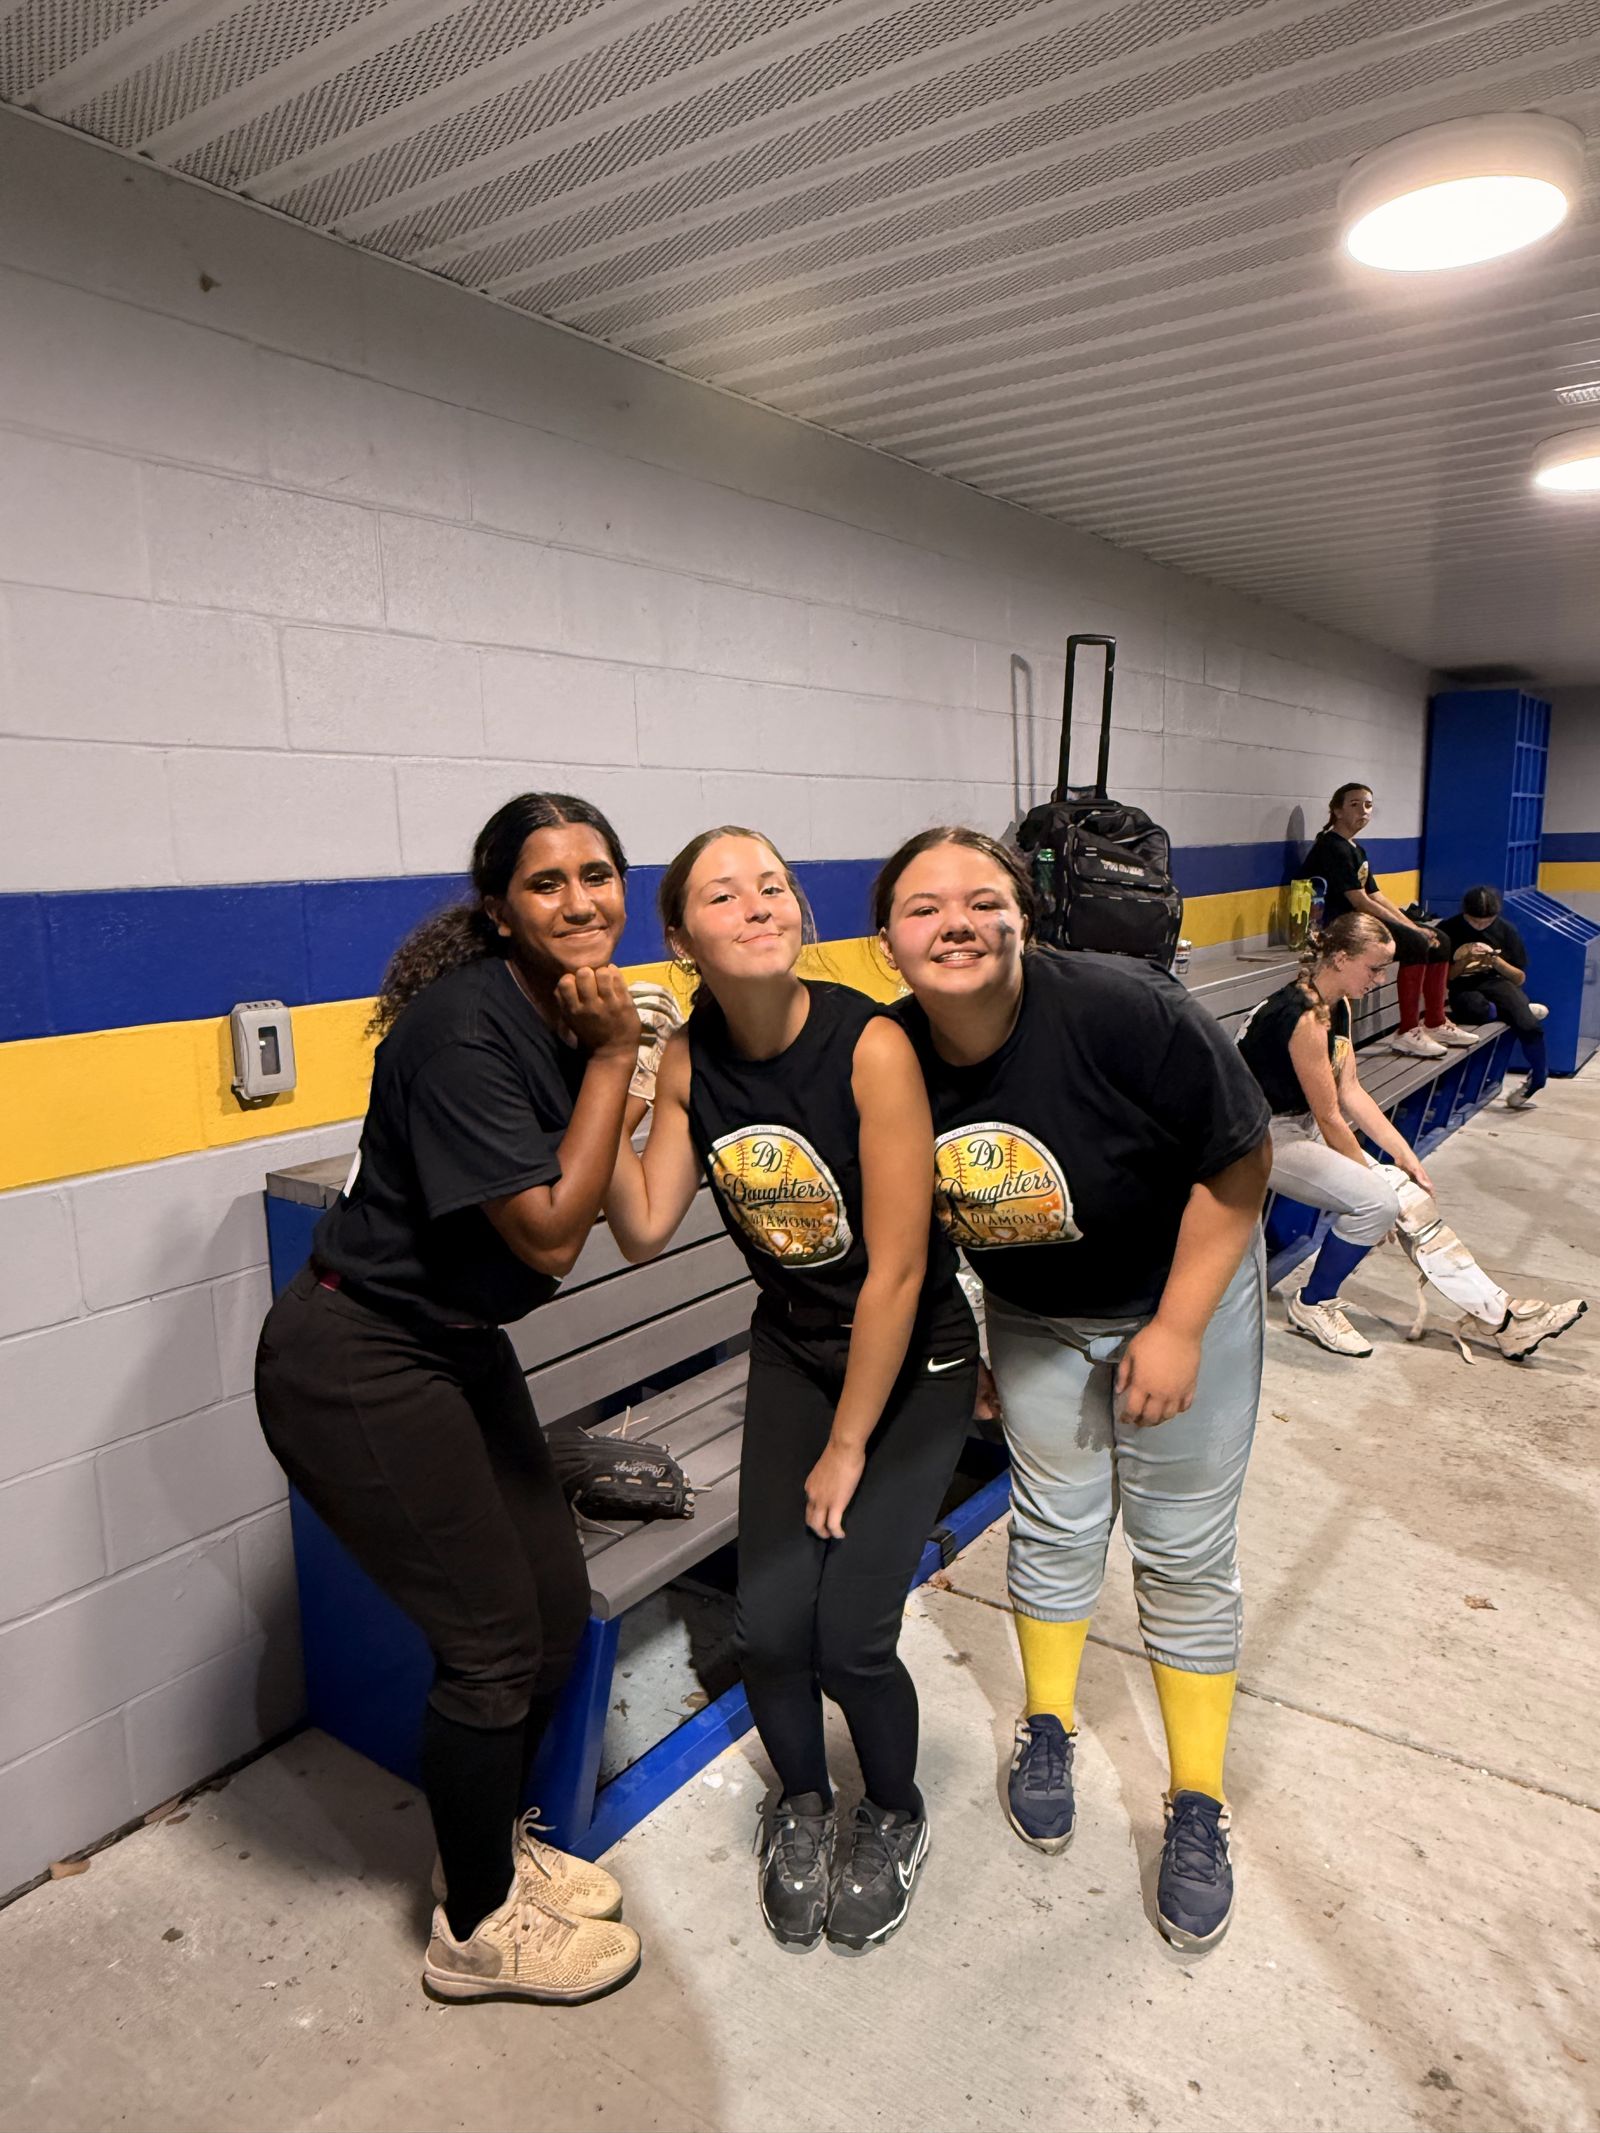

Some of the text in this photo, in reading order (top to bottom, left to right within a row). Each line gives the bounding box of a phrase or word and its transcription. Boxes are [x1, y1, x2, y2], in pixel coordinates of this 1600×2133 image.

[752, 1140, 783, 1173] DD
[967, 1138, 1004, 1171] DD
[723, 1173, 831, 1208] Daughters
[938, 1170, 1057, 1208] Daughters
[970, 1211, 1048, 1226] DIAMOND
